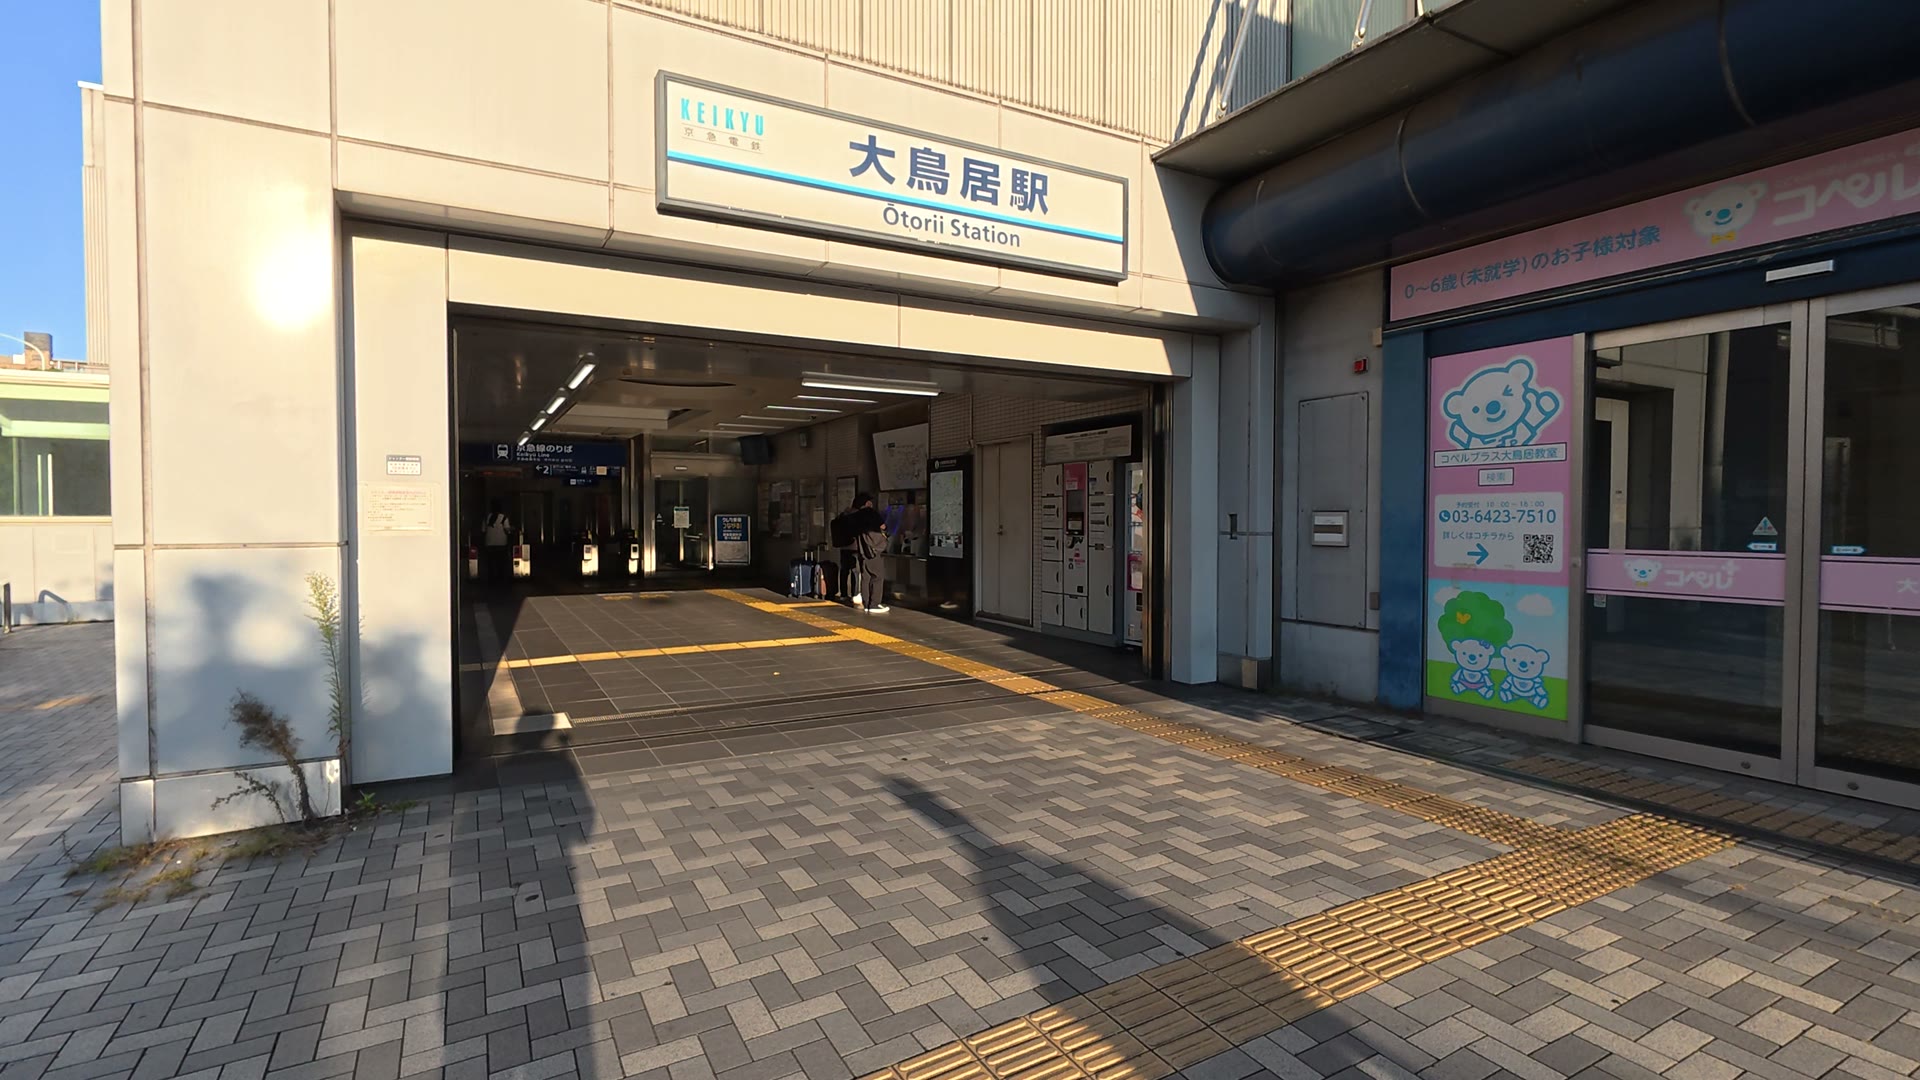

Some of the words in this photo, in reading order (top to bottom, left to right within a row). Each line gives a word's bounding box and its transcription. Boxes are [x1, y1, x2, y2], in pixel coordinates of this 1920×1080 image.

[681, 98, 764, 136] KEIKYU
[684, 127, 761, 151] 京急電鉄
[849, 134, 1049, 215] 大鳥居駅
[883, 202, 944, 235] Ōtorii
[950, 218, 1020, 249] Station
[542, 465, 549, 475] 2
[1452, 510, 1556, 523] 03-6423-7510
[1442, 531, 1515, 541] 詳しくはコチラから
[1896, 577, 1920, 594] 大
